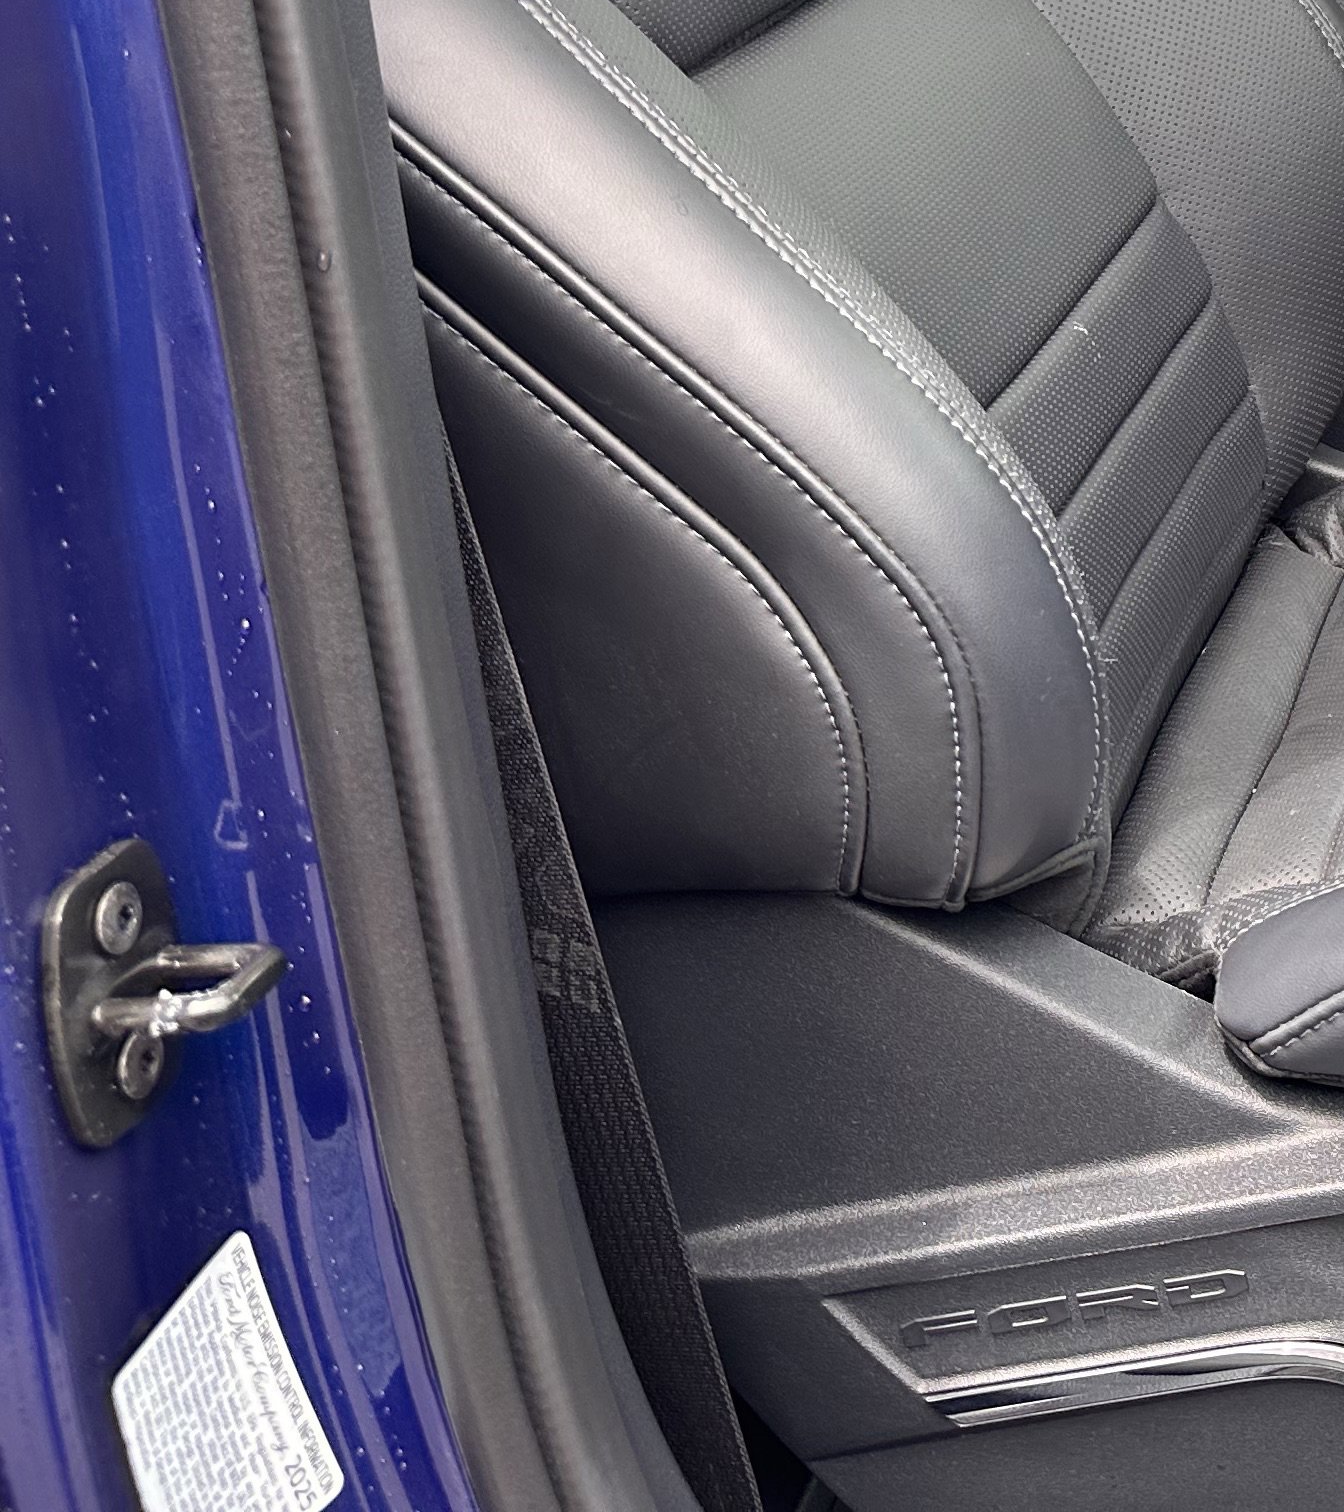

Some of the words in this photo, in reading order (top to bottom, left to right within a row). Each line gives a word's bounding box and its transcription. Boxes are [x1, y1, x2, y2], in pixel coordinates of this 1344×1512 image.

[901, 1268, 1249, 1348] FORD
[231, 1242, 255, 1293] VEHICLE
[246, 1286, 266, 1325] NOISE
[258, 1319, 283, 1376] EMISSION
[276, 1370, 303, 1426] CONTROL
[298, 1420, 334, 1495] INFORMATION
[285, 1454, 317, 1511] 2025
